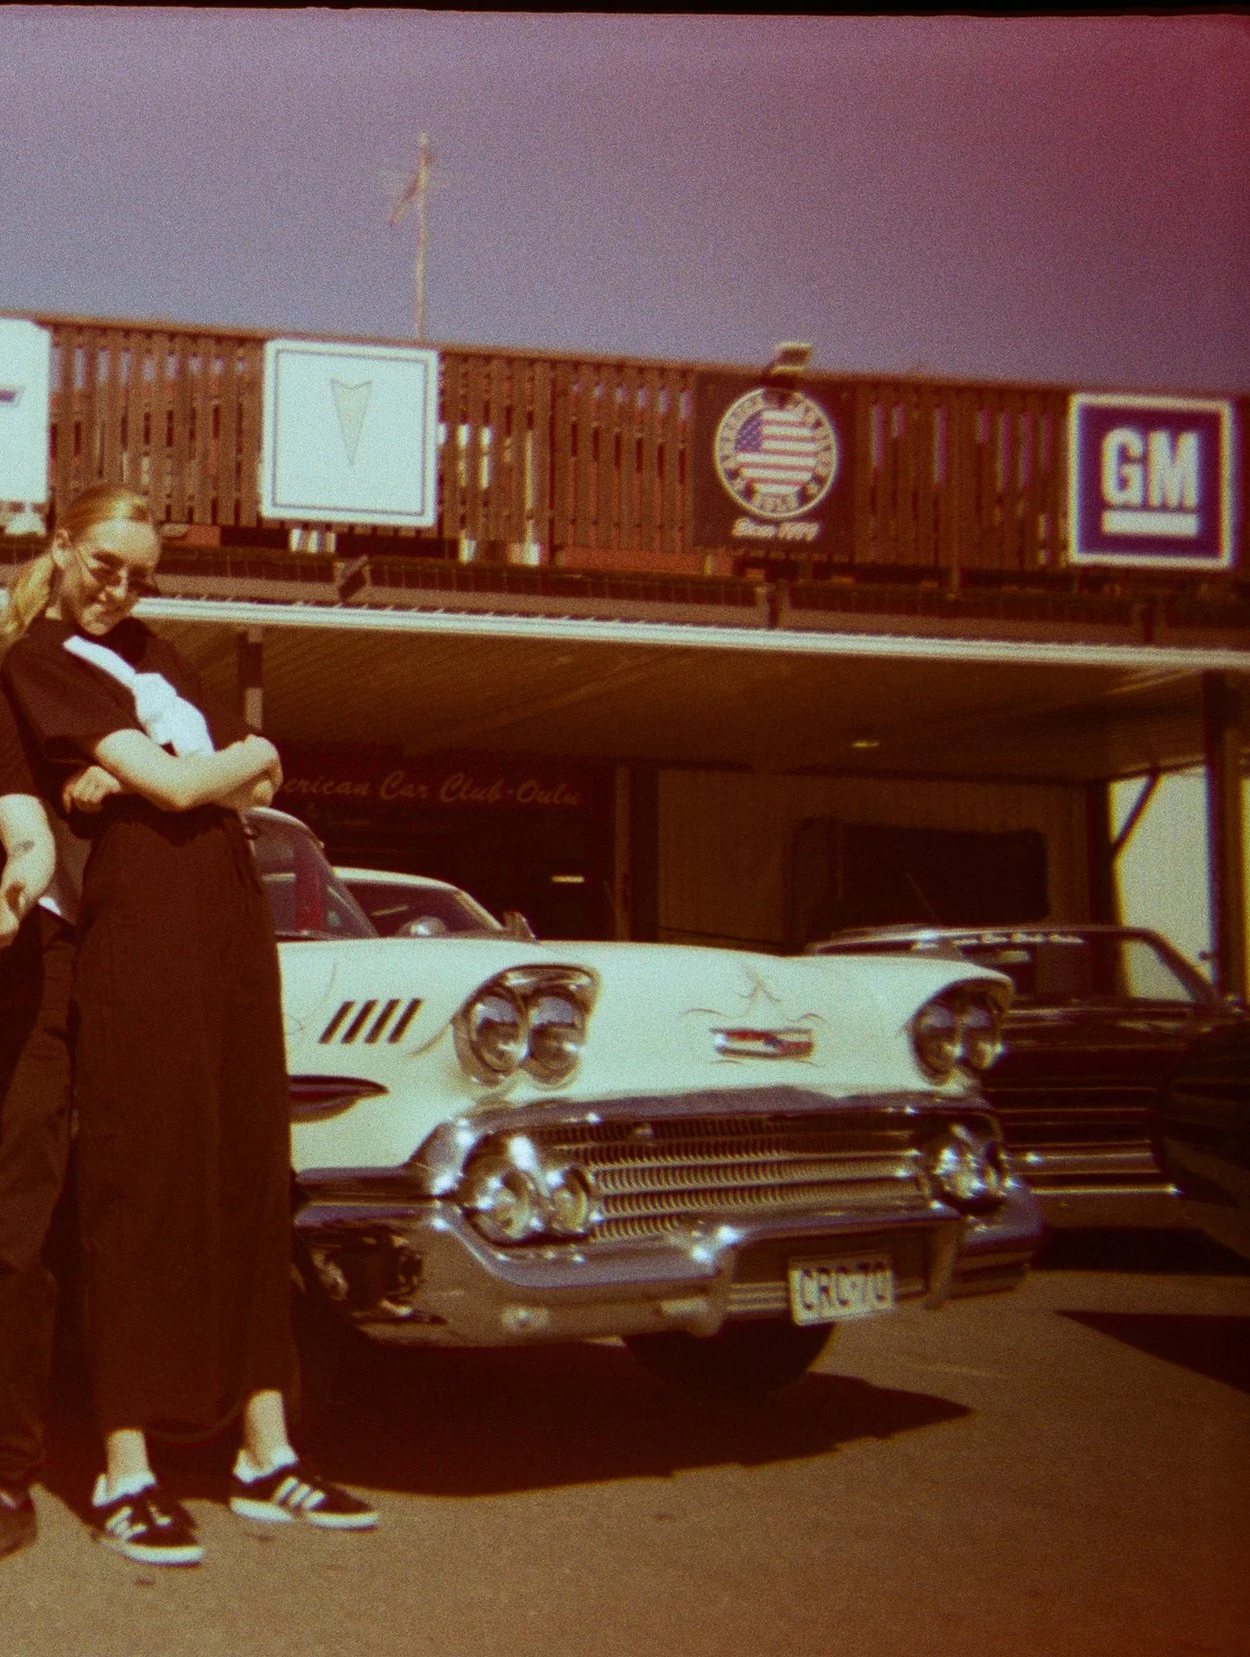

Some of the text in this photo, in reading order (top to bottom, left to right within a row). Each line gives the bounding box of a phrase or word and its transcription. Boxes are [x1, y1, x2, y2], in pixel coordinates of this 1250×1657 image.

[1101, 427, 1199, 510] GM
[283, 774, 368, 796] erican
[380, 770, 427, 800] Car
